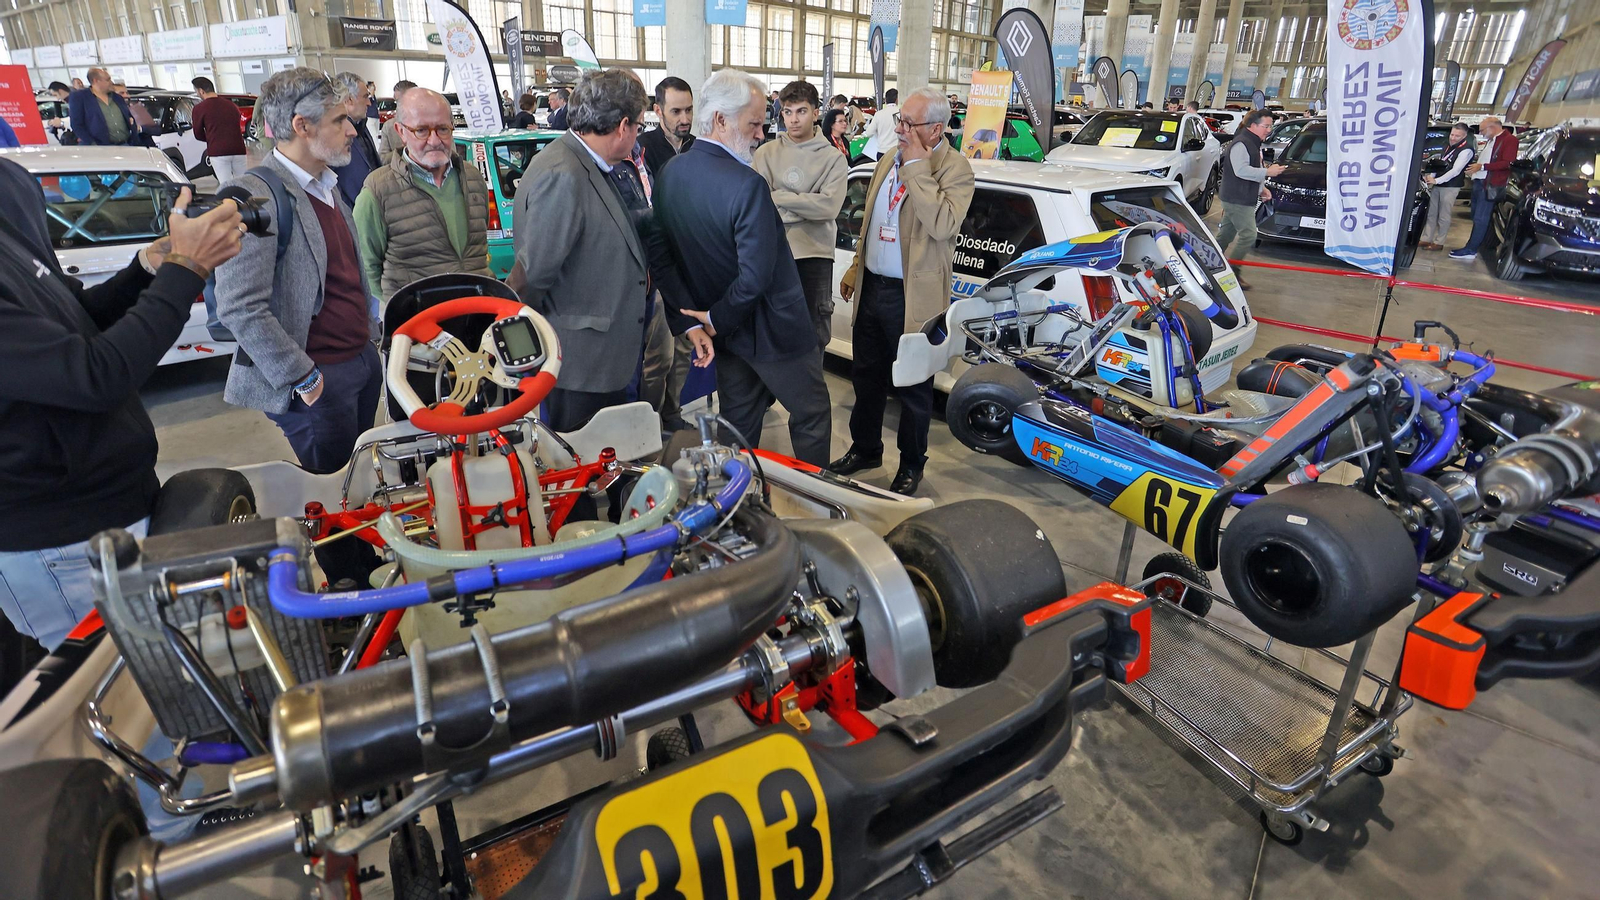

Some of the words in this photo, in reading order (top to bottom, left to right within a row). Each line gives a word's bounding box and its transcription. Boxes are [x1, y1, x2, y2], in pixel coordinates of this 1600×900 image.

[970, 84, 1003, 97] RENAULT
[1004, 85, 1009, 98] 5
[475, 143, 486, 162] AUTO
[955, 233, 1016, 255] Diosdado
[951, 250, 985, 269] Milena
[1165, 254, 1187, 284] Praga
[1220, 344, 1240, 361] JEREZ
[1063, 442, 1100, 460] ANTONIO
[1100, 455, 1134, 472] RIVERA
[1145, 477, 1202, 552] 67
[613, 767, 825, 900] 303
